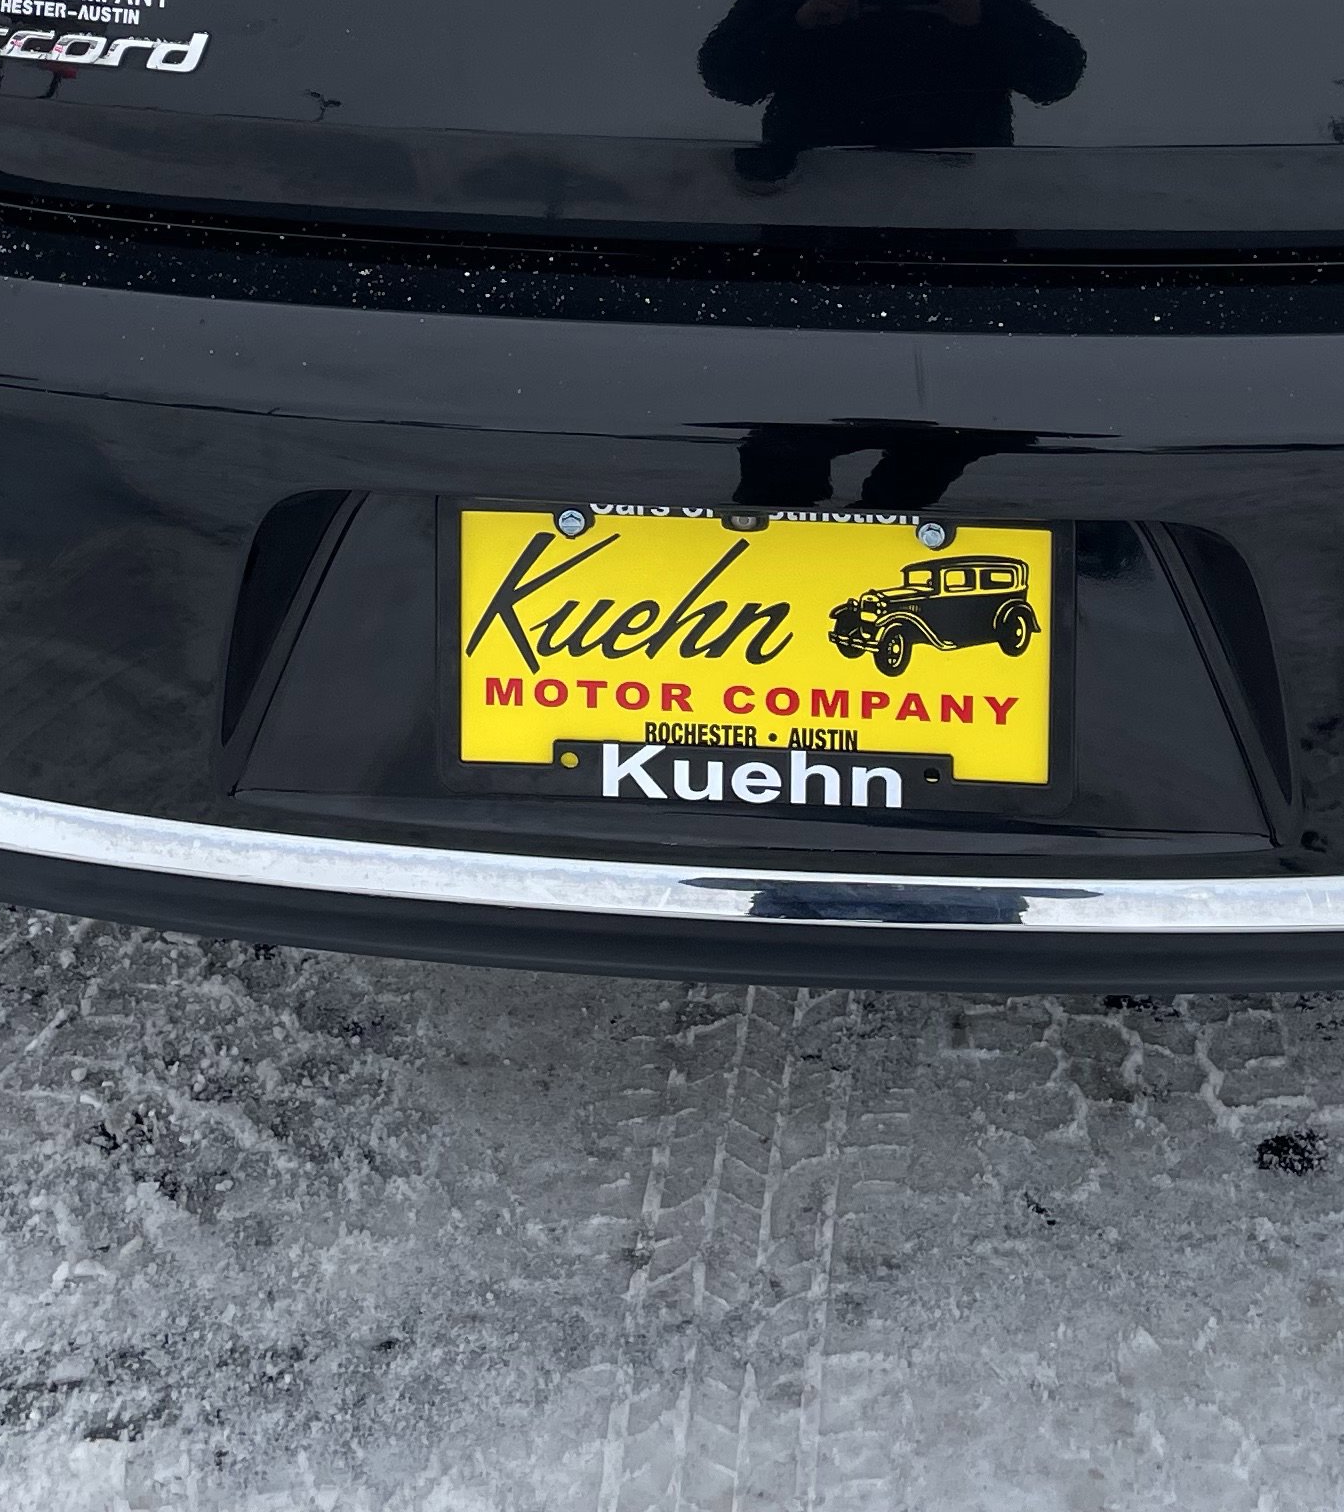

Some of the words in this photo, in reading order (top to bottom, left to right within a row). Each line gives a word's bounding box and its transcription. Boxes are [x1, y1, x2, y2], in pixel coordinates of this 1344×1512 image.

[465, 530, 794, 675] Kuehn
[485, 676, 694, 713] MOTOR
[722, 684, 1020, 726] COMPANY
[644, 721, 757, 748] ROCHESTER
[787, 726, 859, 752] AUSTIN
[601, 742, 904, 808] Kuehn
